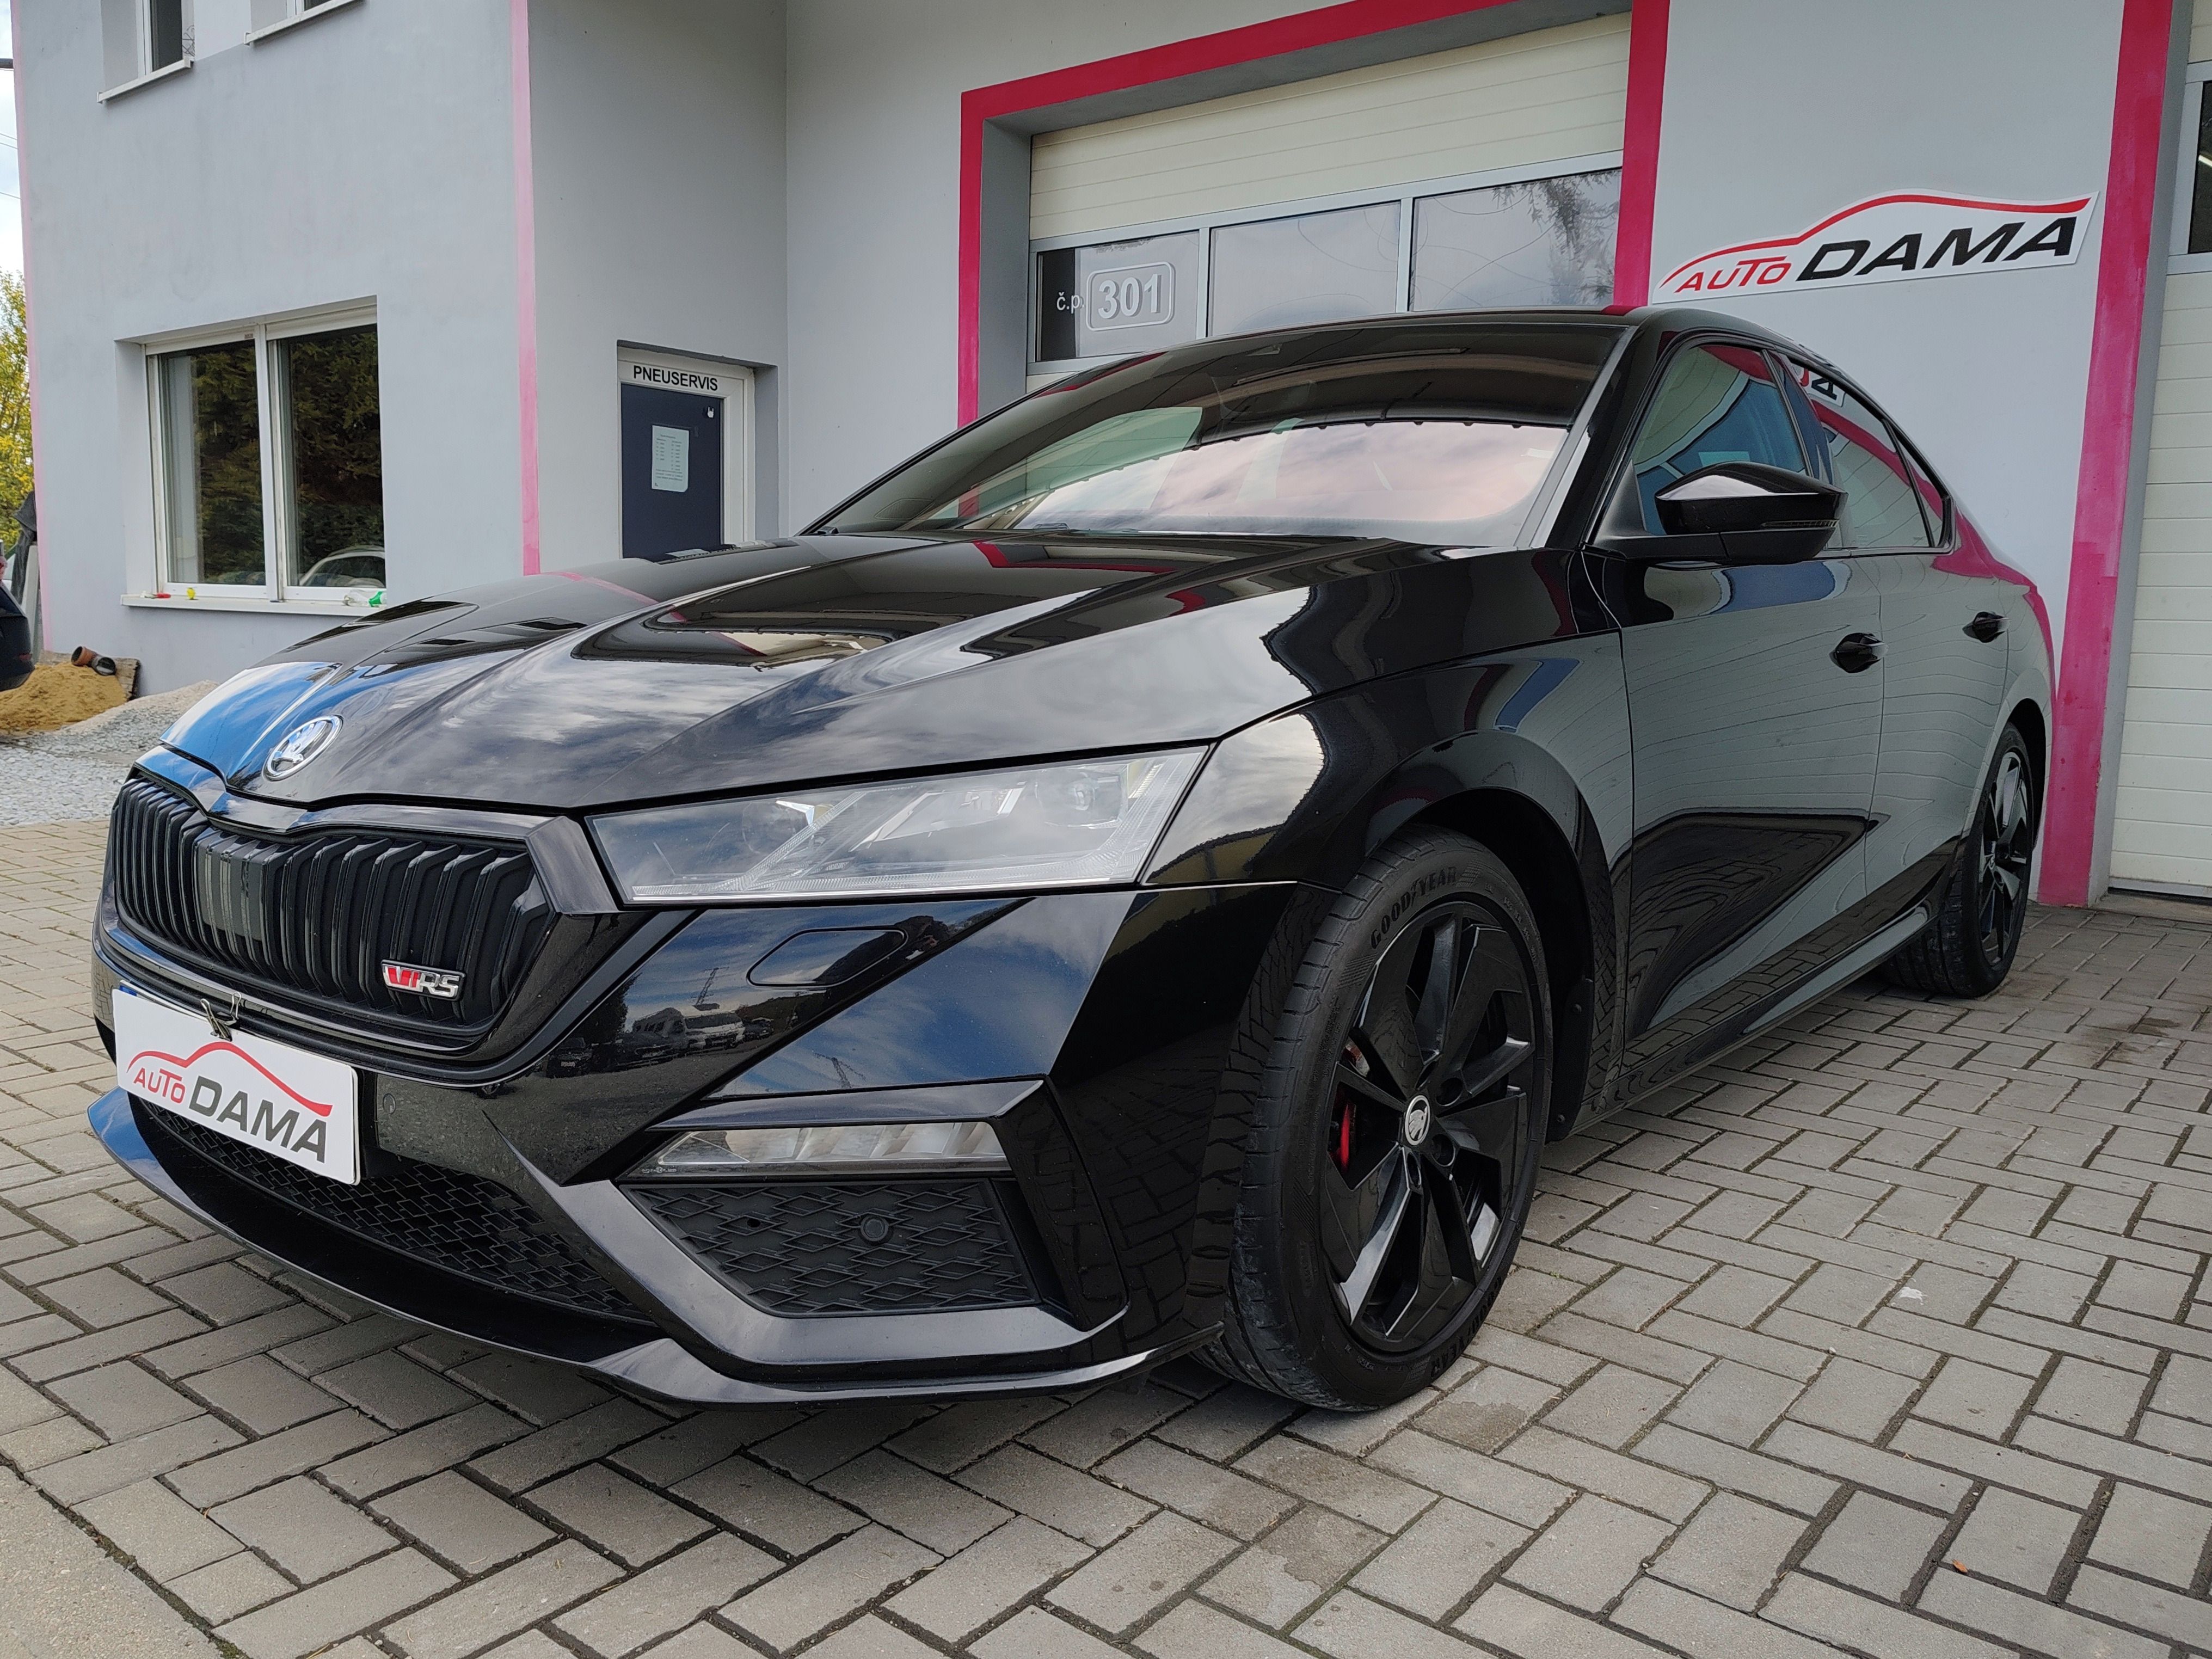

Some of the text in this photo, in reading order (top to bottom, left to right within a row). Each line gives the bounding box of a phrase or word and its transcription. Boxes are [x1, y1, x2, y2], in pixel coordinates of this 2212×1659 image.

[1674, 216, 2078, 293] AUTO DAMA
[1056, 273, 1159, 319] č.p. 301
[633, 365, 718, 391] PNEUSERVIS
[1371, 866, 1457, 949] GOODYEAR
[133, 1067, 327, 1164] AUTO DAMA
